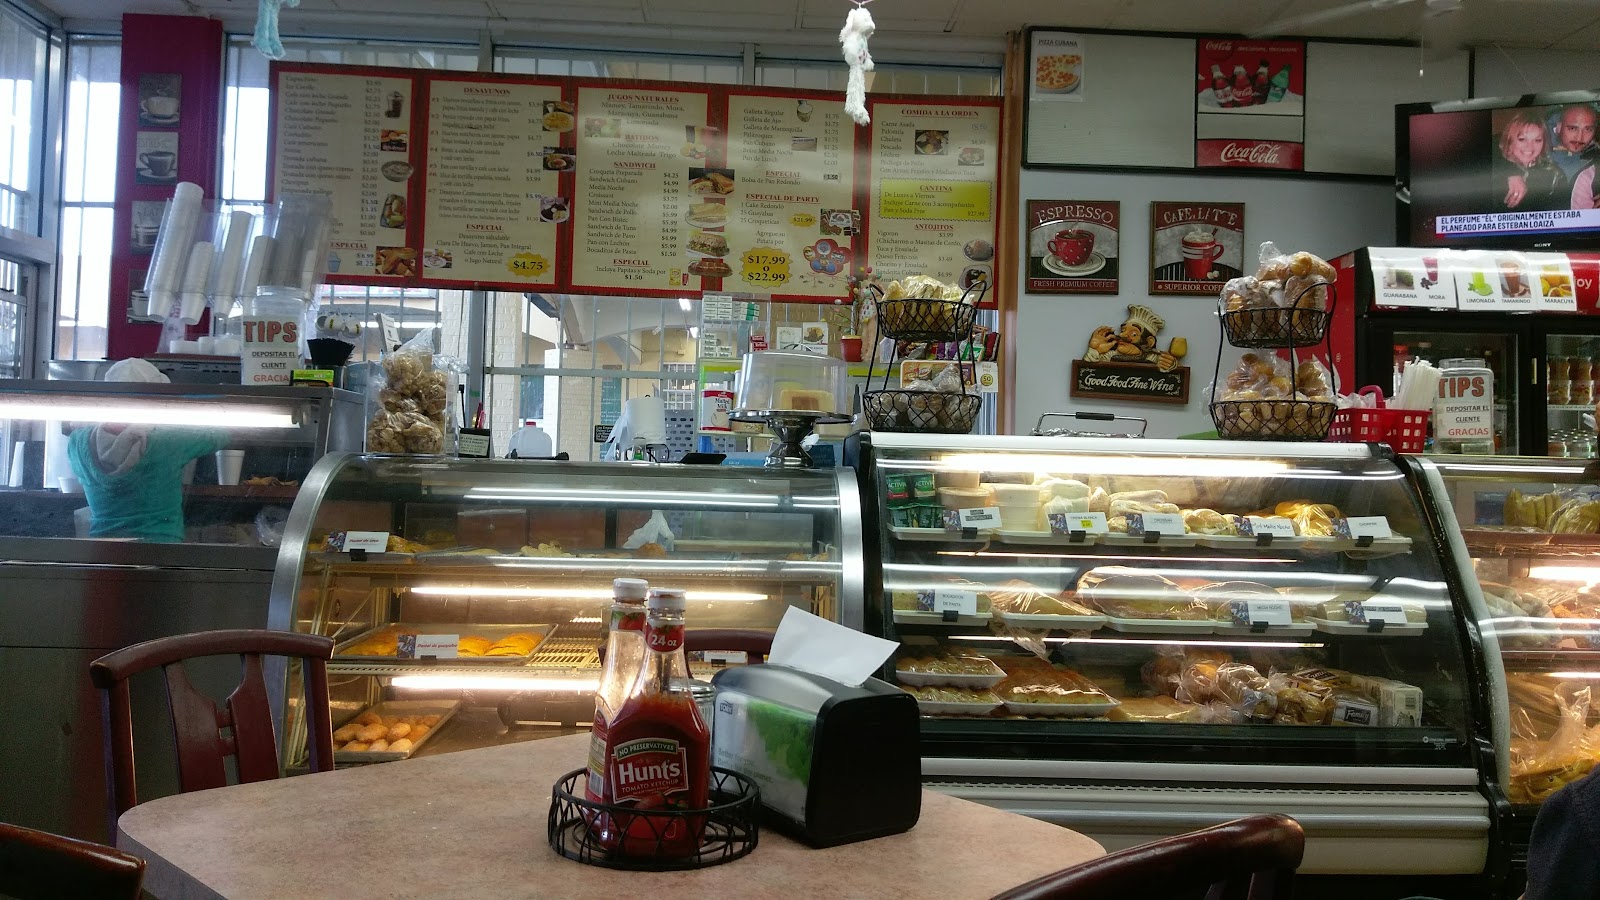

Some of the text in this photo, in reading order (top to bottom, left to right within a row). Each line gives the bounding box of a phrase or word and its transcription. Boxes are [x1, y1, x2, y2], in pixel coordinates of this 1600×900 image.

[463, 87, 511, 95] DESAYUNOS
[635, 95, 679, 103] NATURALES
[1036, 205, 1114, 224] ESPRESSO
[1482, 214, 1497, 222] "ÉL"
[1497, 212, 1552, 221] ORIGINALMENTE
[1553, 211, 1581, 219] ESTABA
[1441, 220, 1554, 232] PLANEADO PARA ESTEBAN LOAIZA
[513, 260, 543, 270] $4.75
[747, 255, 786, 265] $17.99
[747, 272, 786, 281] $22.99
[1164, 283, 1201, 291] SUPERIOR
[243, 320, 297, 343] TIPS
[253, 374, 290, 382] GRACIA
[1085, 374, 1175, 391] Good Food Fine Wine
[1438, 376, 1485, 398] TIPS
[1448, 428, 1489, 436] GRACIAS
[652, 635, 677, 647] 24 oz
[619, 742, 674, 757] NO PRESERVATIVES
[618, 760, 681, 785] Hunt's
[622, 783, 649, 793] TOMATO
[650, 779, 679, 788] KETCHUP
